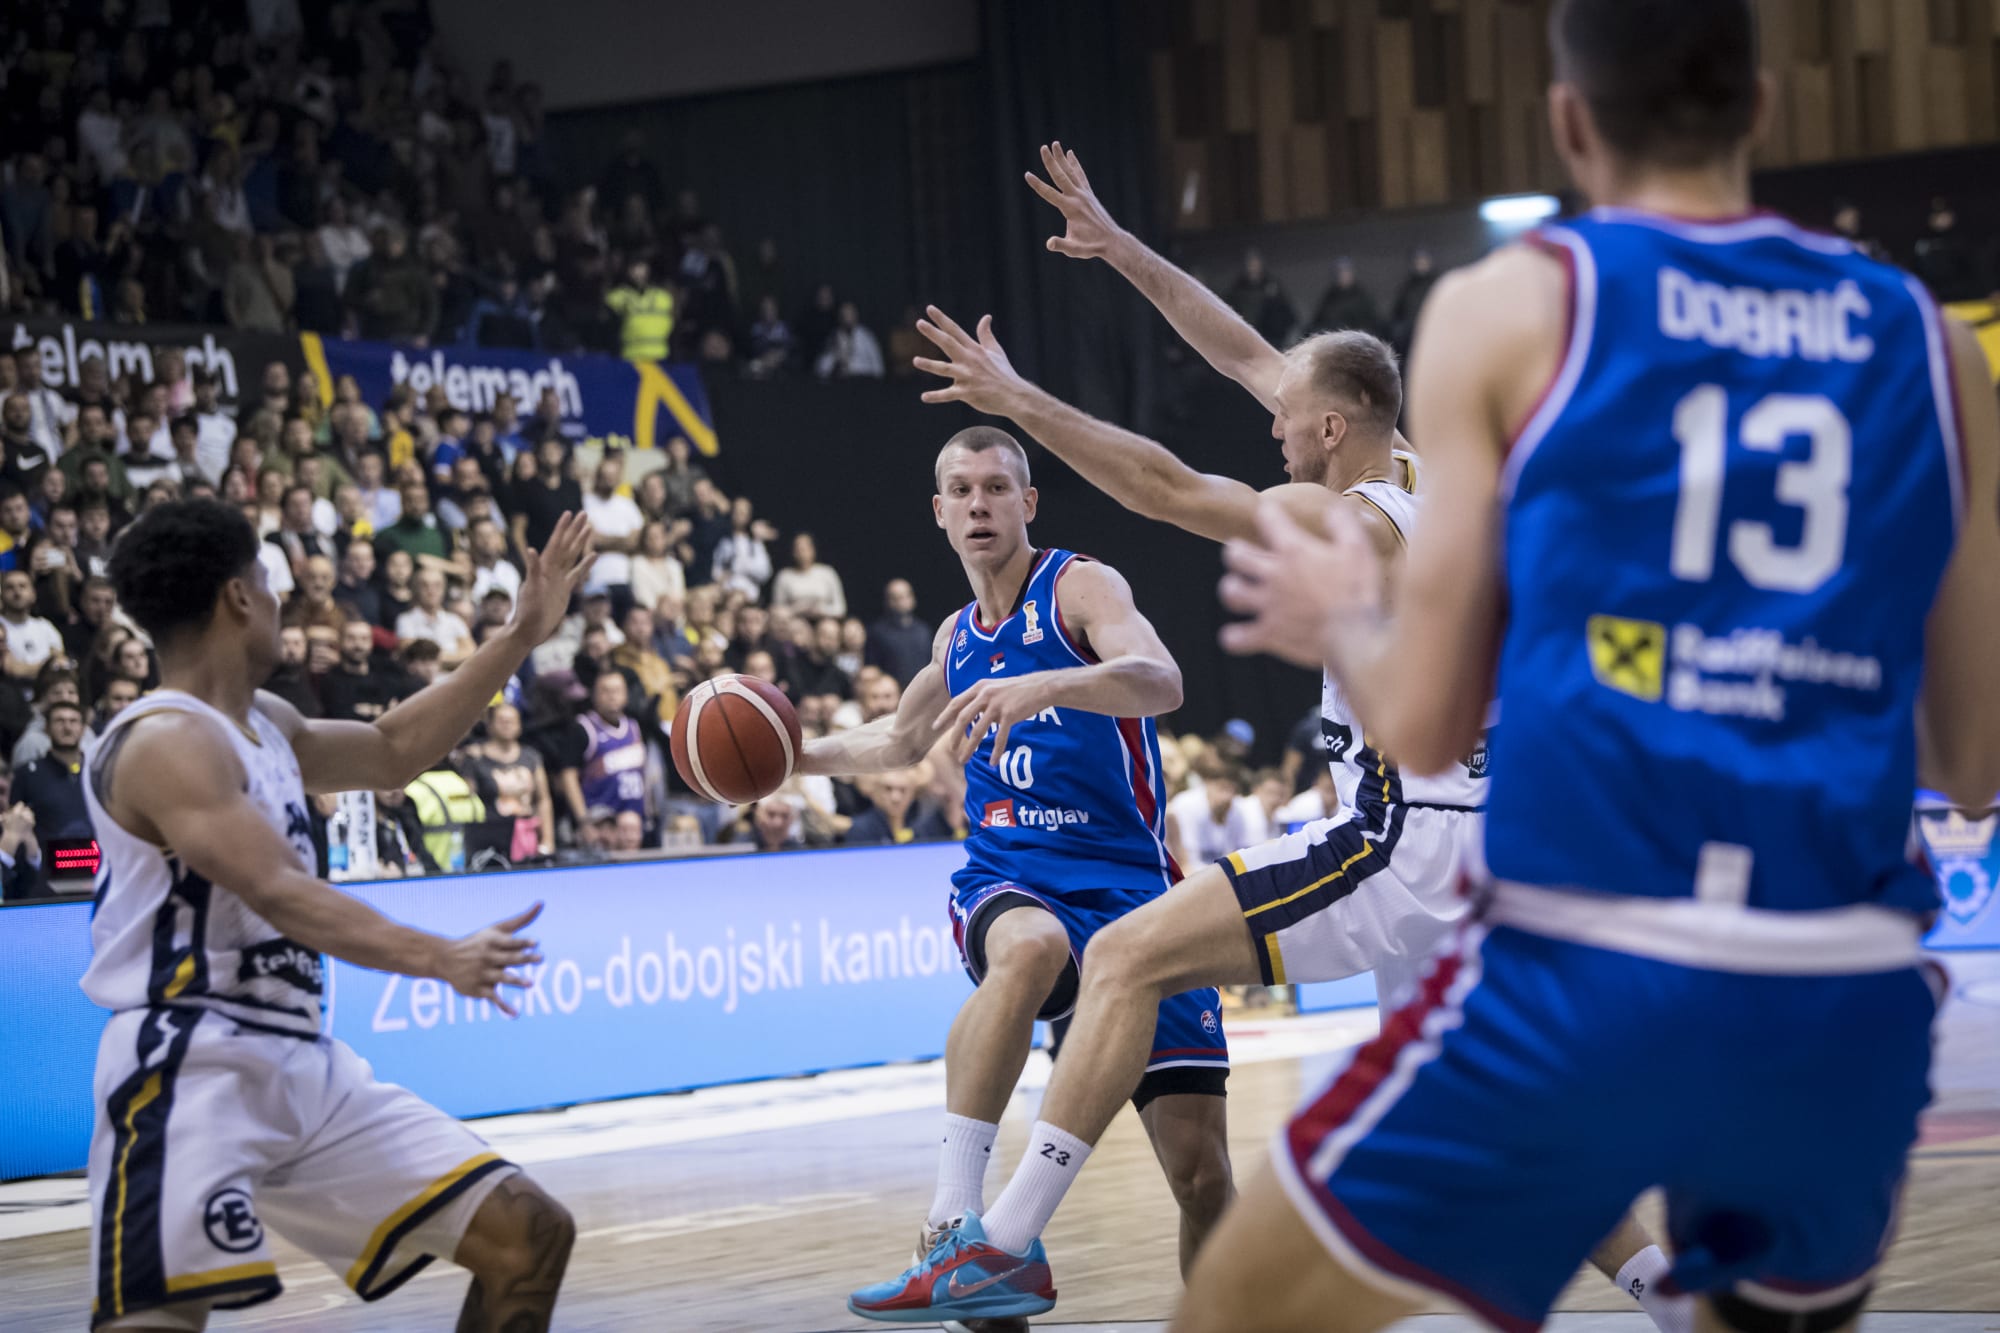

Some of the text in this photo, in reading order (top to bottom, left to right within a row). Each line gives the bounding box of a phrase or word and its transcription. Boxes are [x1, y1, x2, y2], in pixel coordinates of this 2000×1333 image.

[1669, 382, 1853, 596] 13
[1667, 667, 1787, 722] Bank
[999, 745, 1035, 790] 10
[1018, 805, 1089, 831] triglav
[1040, 1142, 1071, 1167] 23
